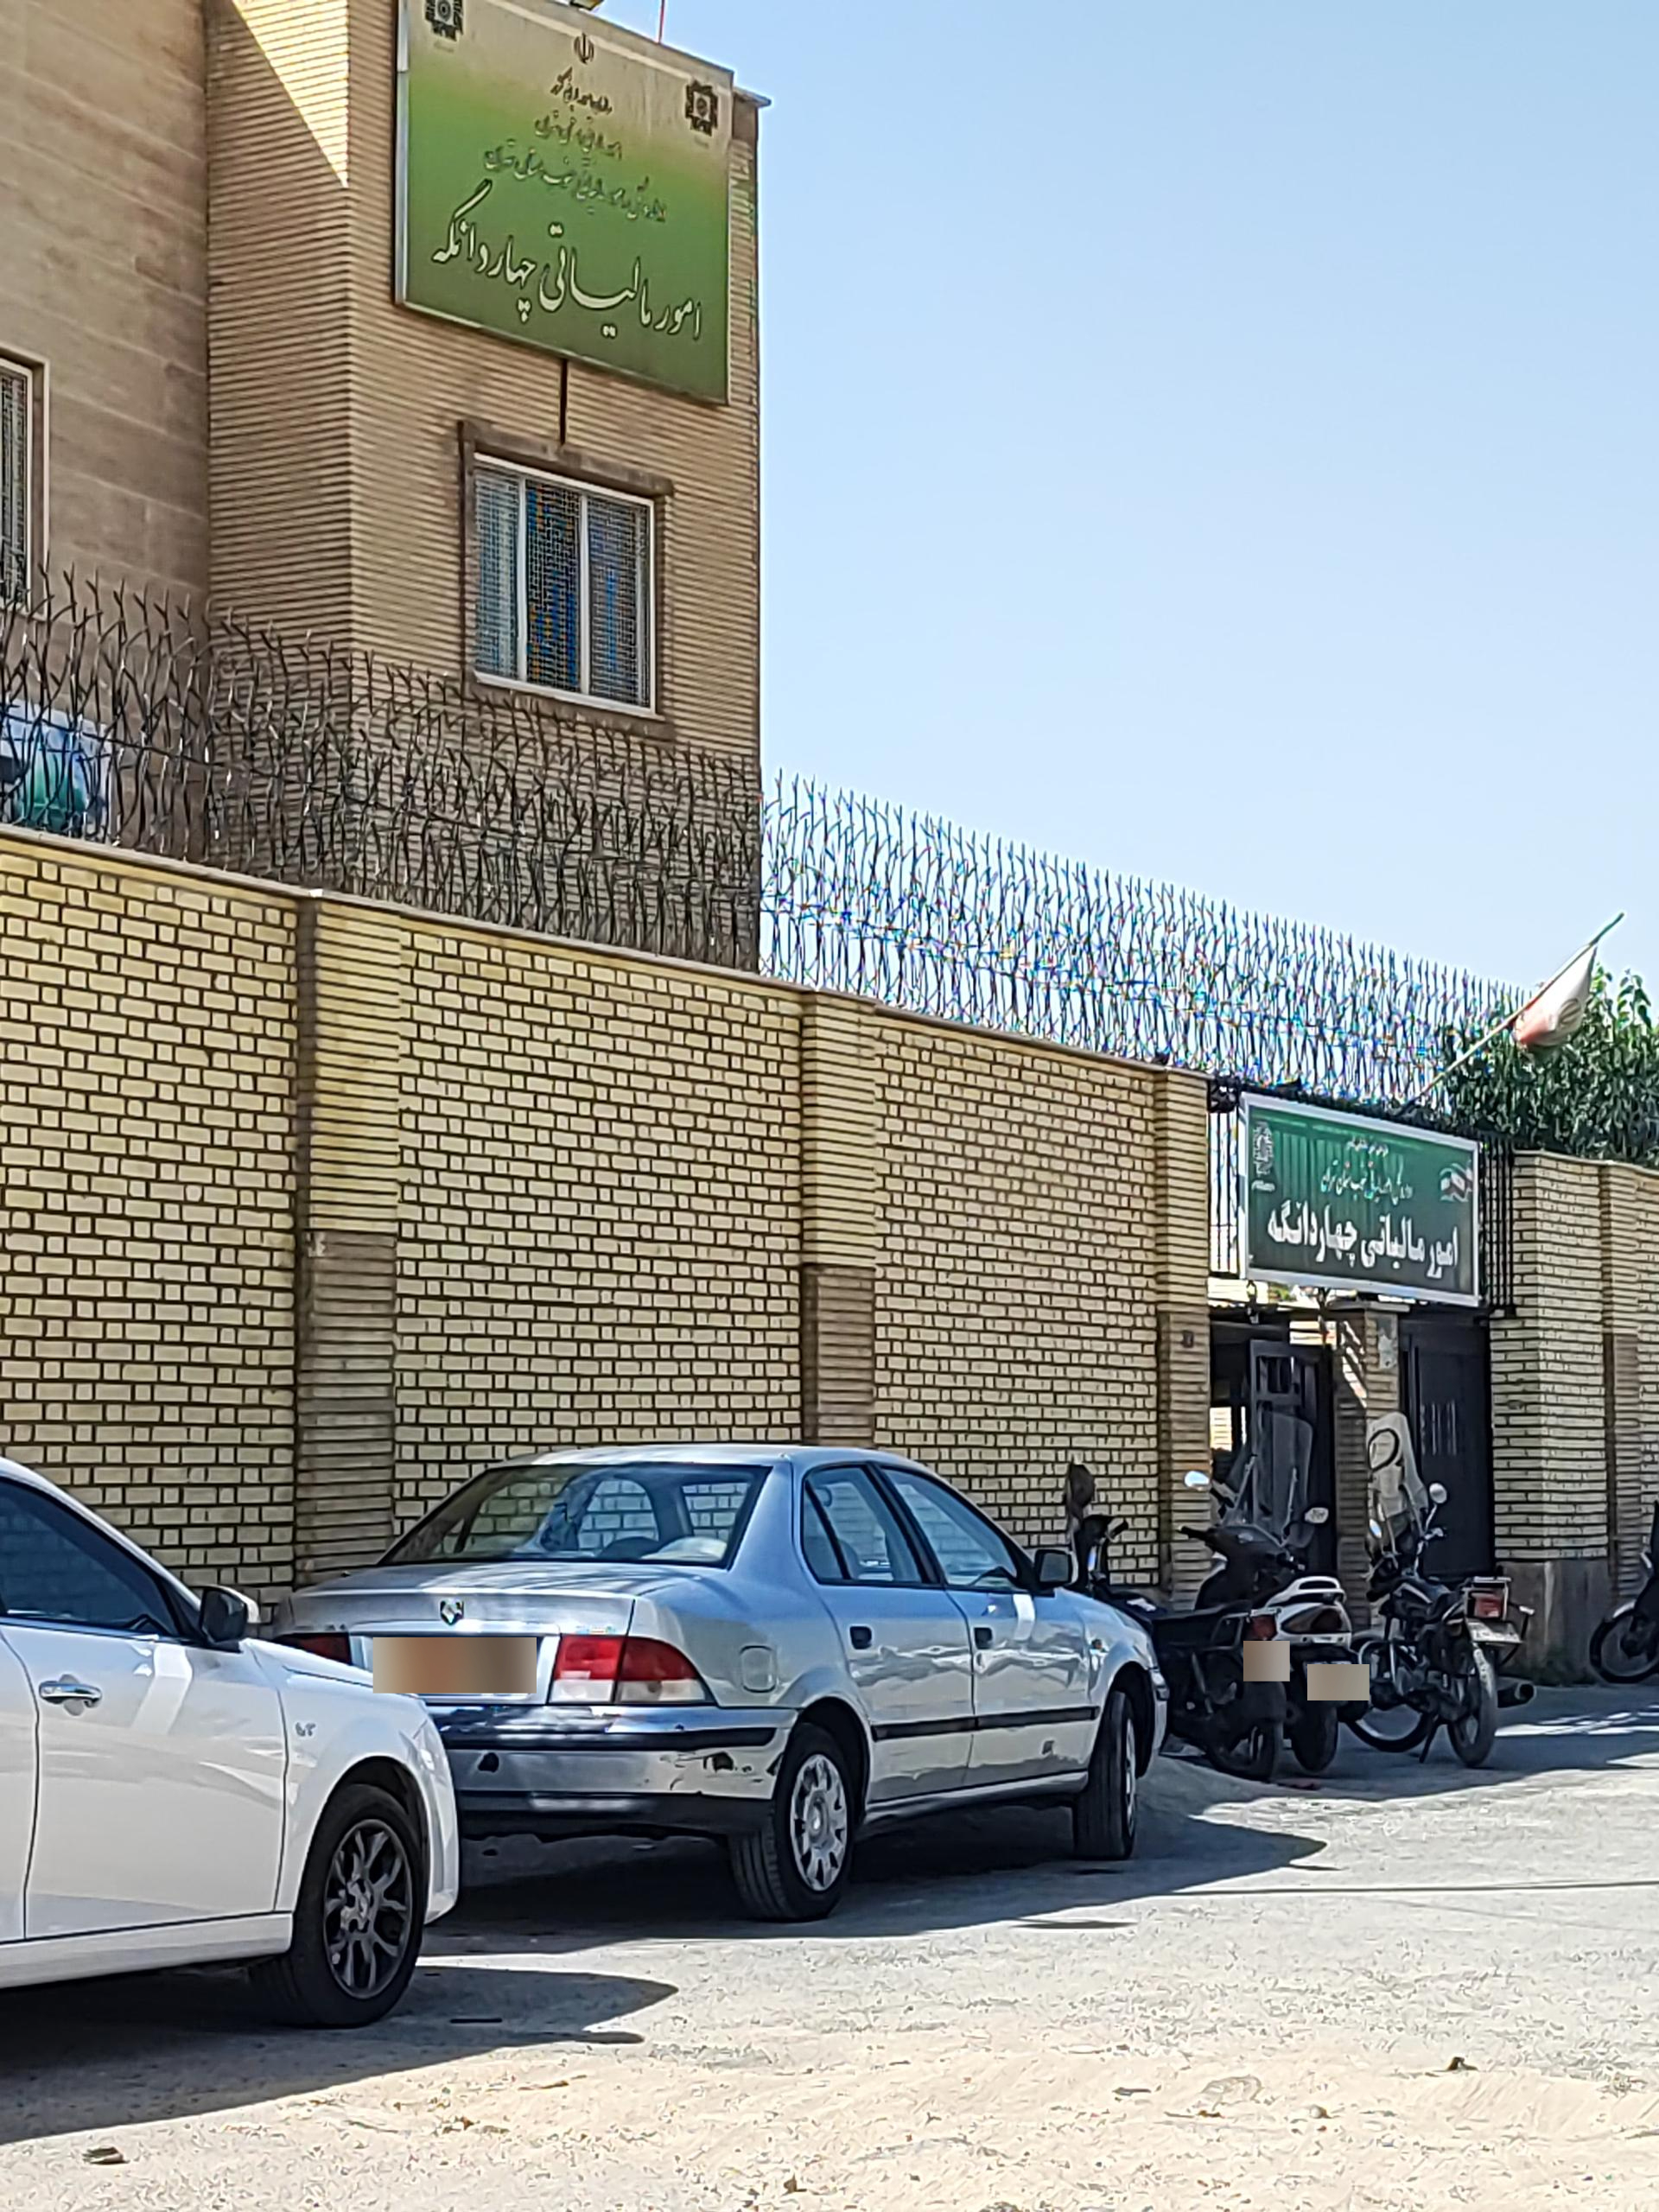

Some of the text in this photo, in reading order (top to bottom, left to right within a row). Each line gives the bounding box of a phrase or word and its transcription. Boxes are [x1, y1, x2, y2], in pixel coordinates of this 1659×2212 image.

[538, 221, 652, 338] مالیاتی
[654, 298, 701, 339] امور
[1360, 1213, 1425, 1269] مالیاتی
[1427, 1226, 1458, 1279] امور
